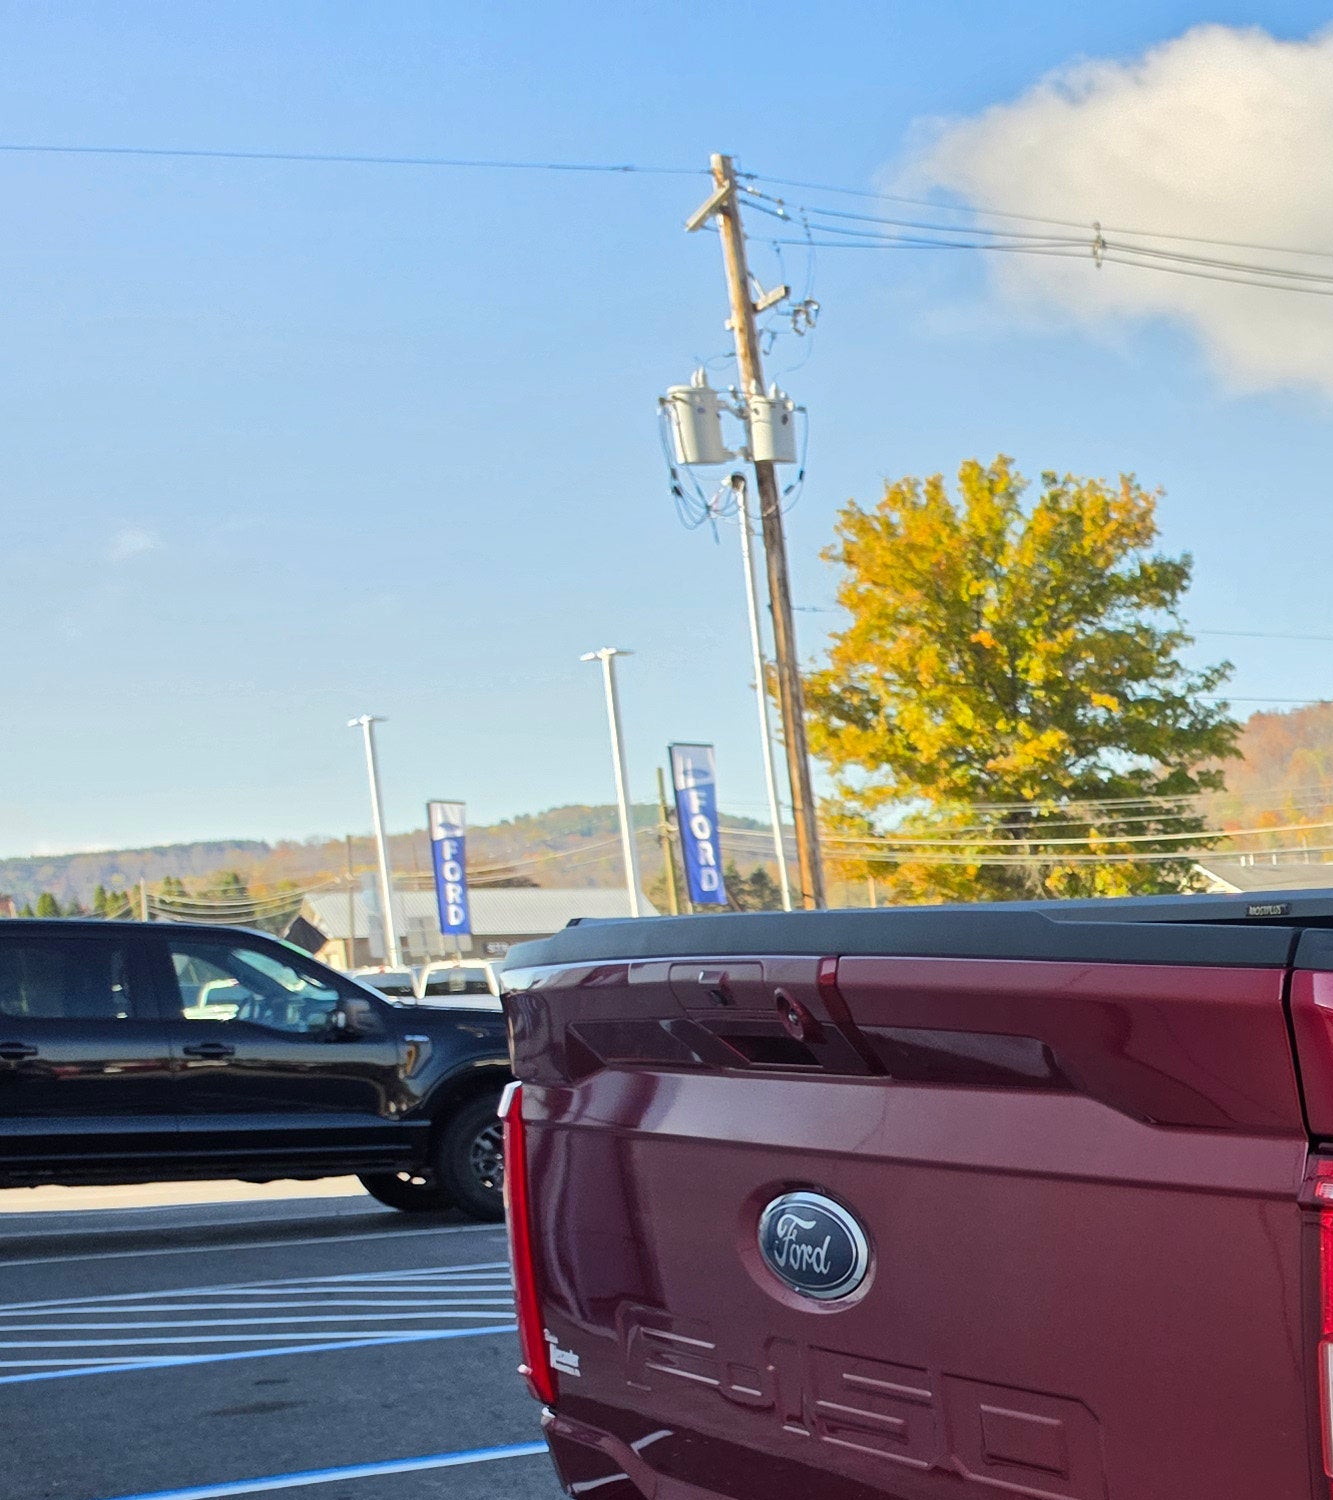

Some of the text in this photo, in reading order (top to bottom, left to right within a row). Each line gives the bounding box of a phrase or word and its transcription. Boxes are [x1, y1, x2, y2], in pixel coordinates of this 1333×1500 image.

[442, 839, 465, 926] FORD
[689, 788, 719, 892] FORD
[774, 1213, 831, 1275] Ford
